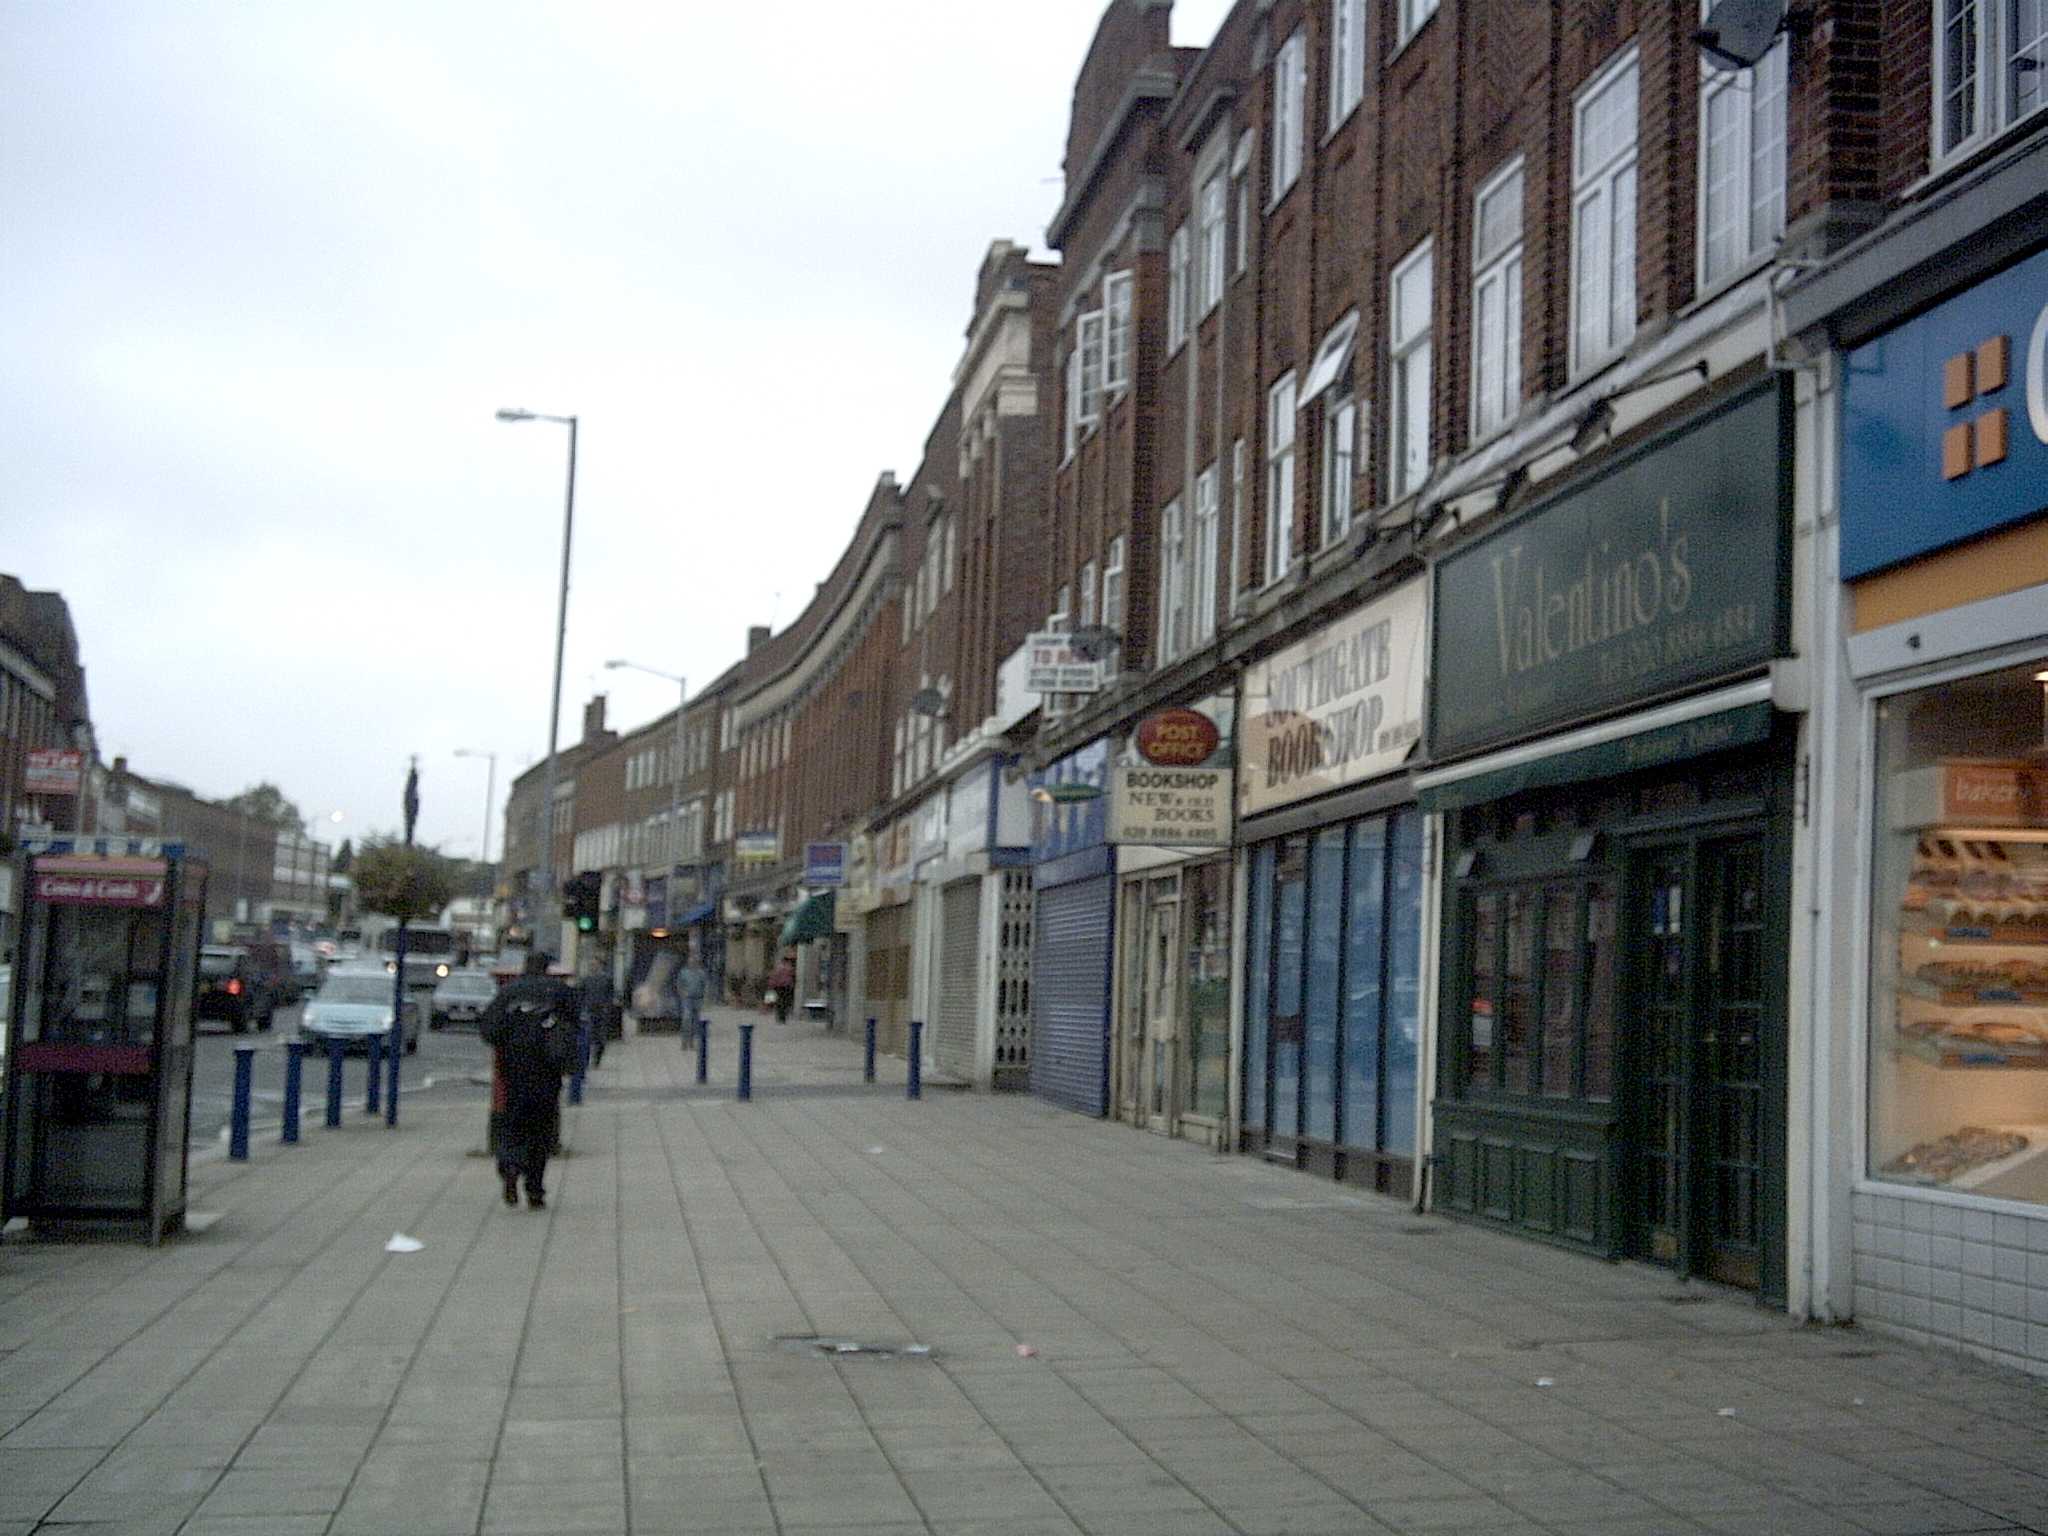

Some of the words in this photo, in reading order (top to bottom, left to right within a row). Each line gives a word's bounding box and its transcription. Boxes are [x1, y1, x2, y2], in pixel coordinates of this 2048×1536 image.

[1493, 497, 1690, 677] Valentino's
[1264, 617, 1393, 730] SOUTHGATE
[1156, 724, 1203, 740] POST
[1150, 741, 1206, 757] OFFICE
[1127, 771, 1218, 789] BOOKSHOP
[1129, 791, 1173, 807] NEW
[1155, 807, 1215, 823] BOOKS
